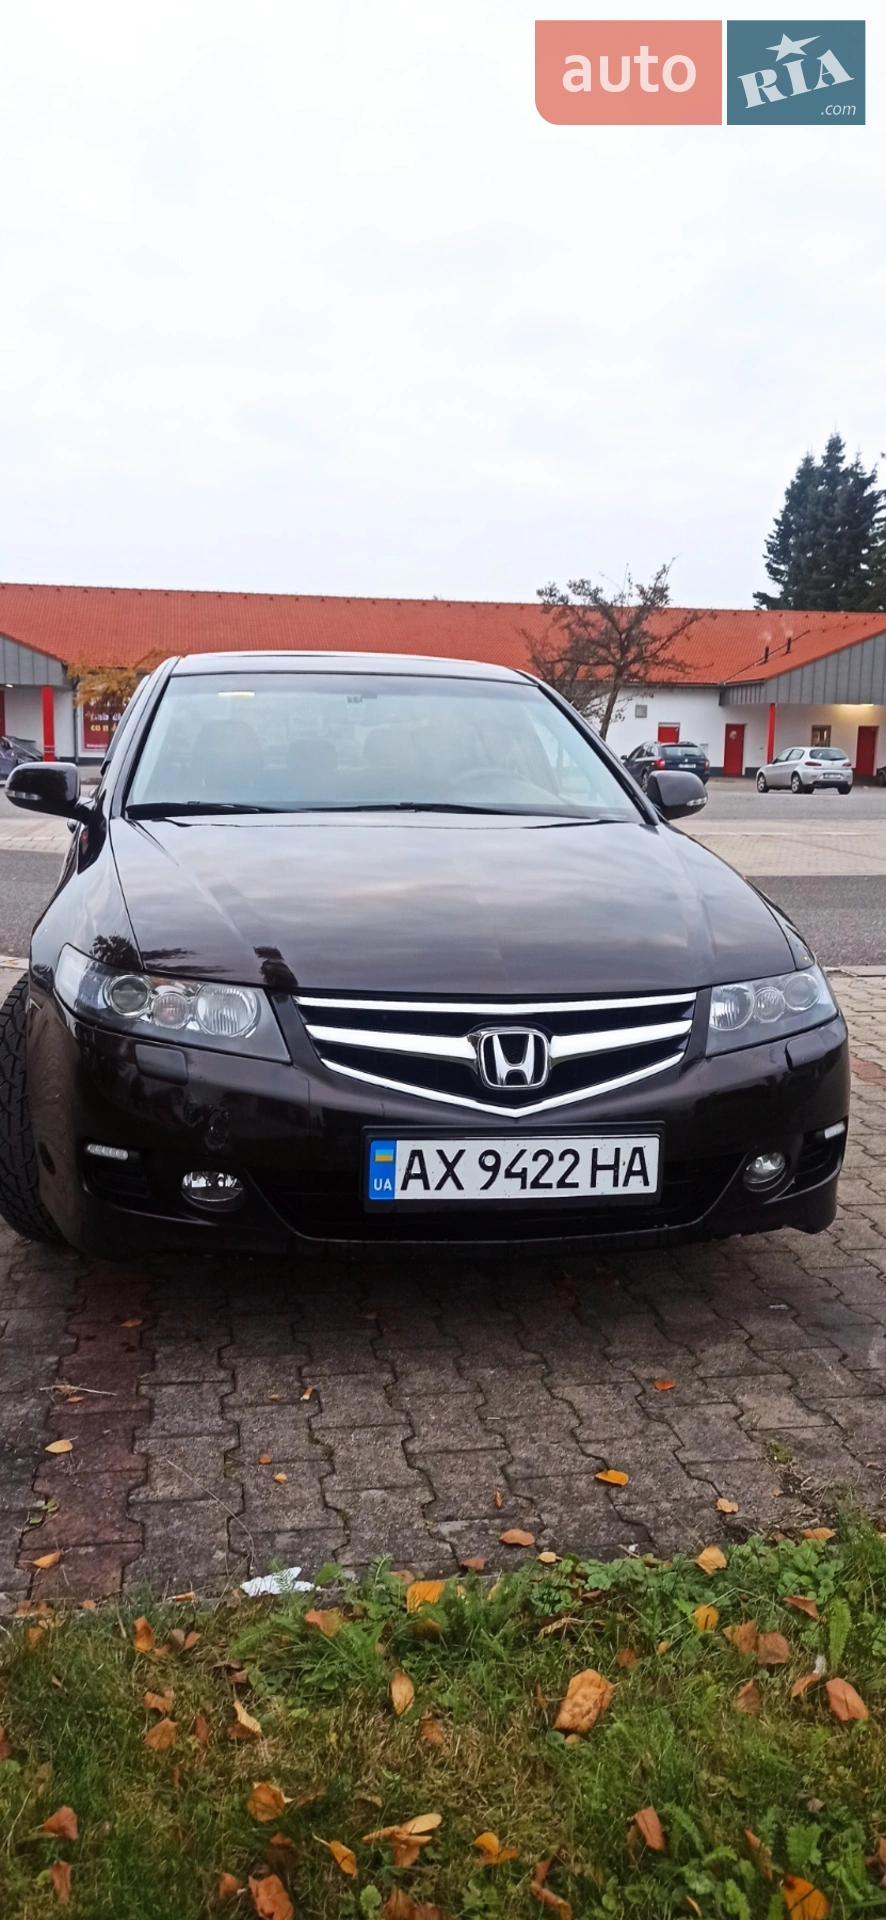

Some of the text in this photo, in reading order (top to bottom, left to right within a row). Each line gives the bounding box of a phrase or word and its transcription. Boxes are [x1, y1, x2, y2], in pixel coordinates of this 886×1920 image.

[400, 1146, 651, 1191] AX 9422 HA
[373, 1177, 393, 1192] UA
